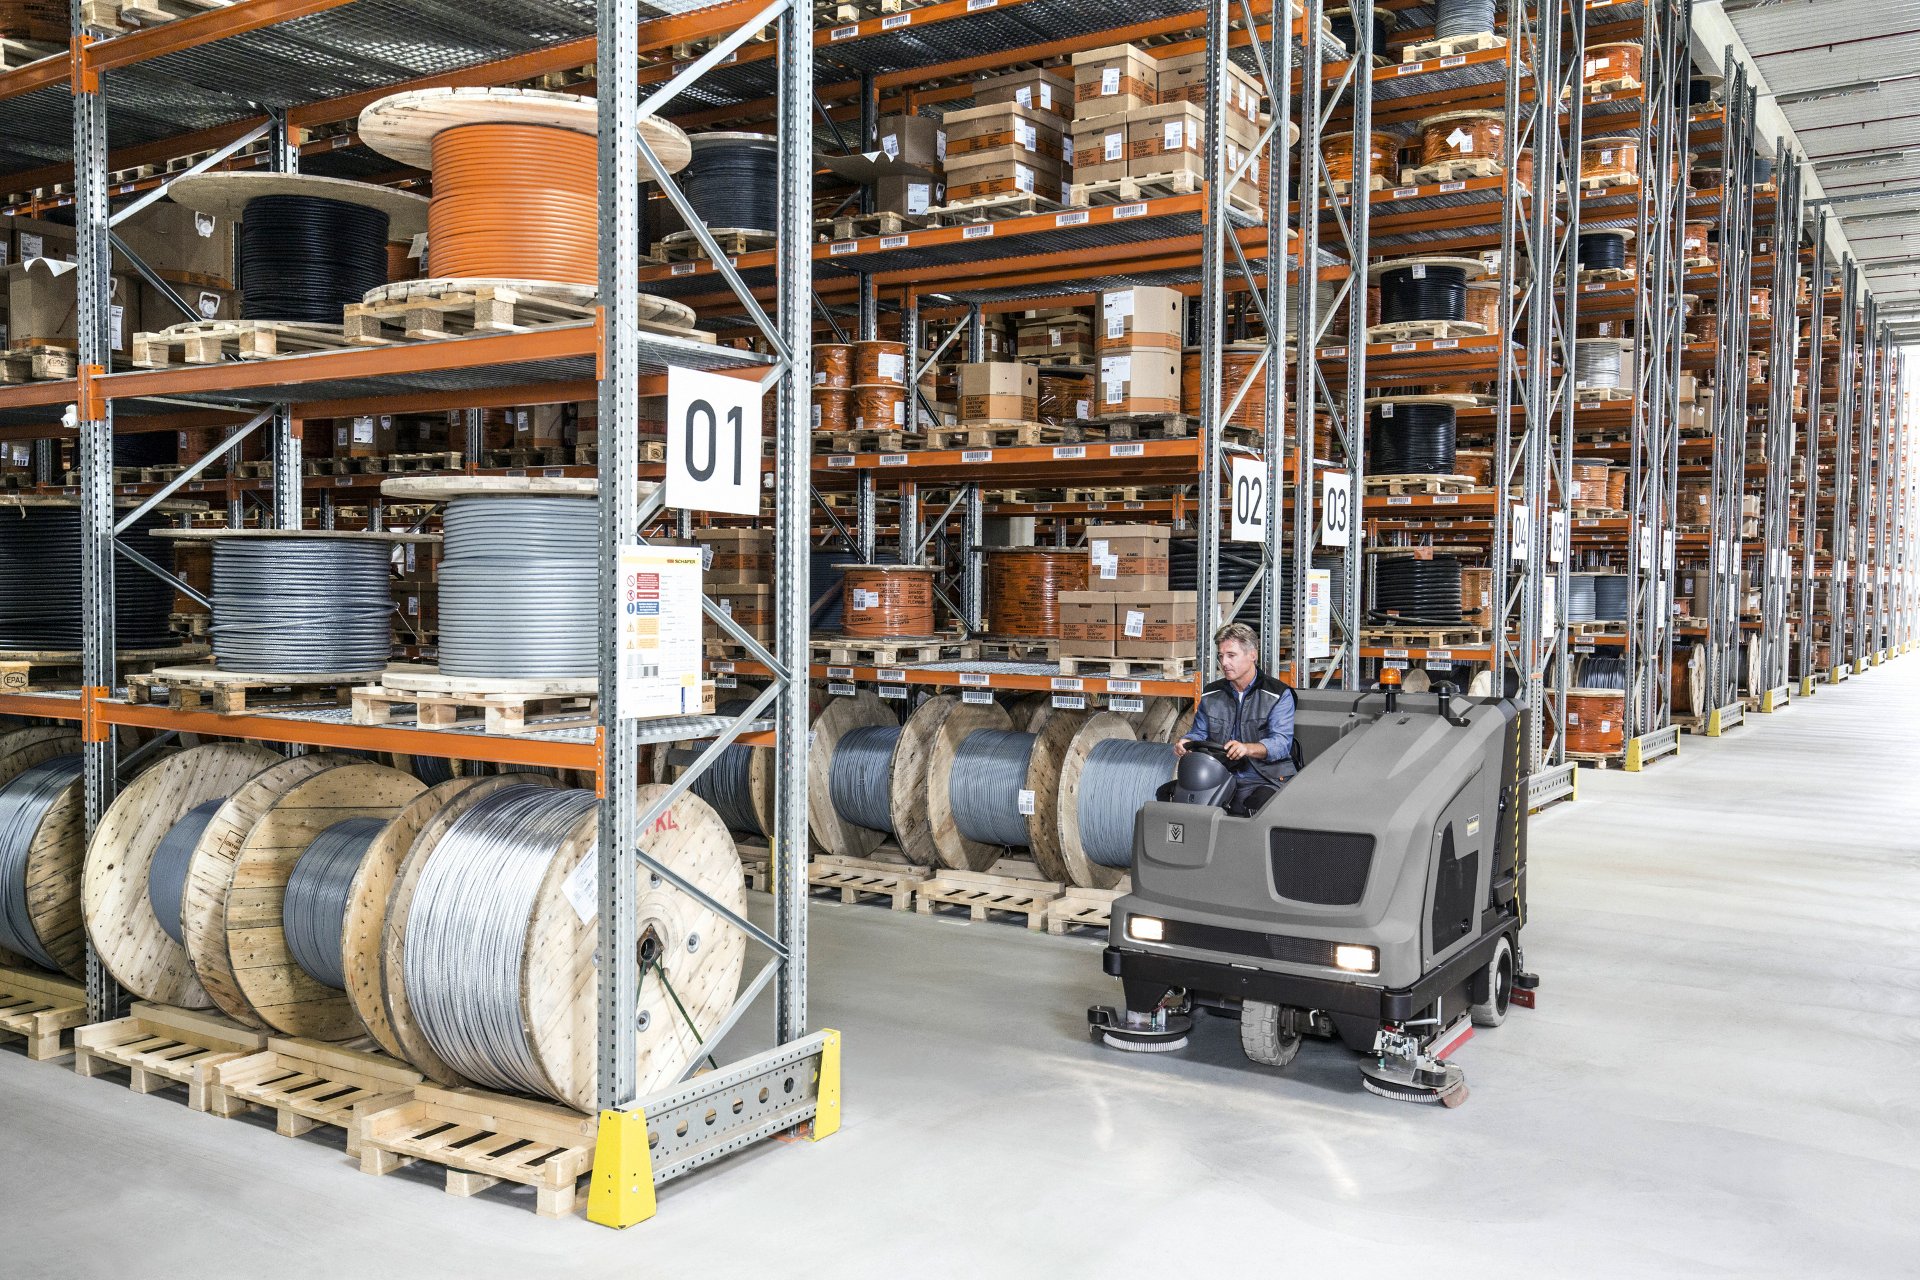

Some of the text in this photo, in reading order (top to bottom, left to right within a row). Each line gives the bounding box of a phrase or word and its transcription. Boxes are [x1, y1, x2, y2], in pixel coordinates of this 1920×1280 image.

[685, 398, 744, 486] 01
[1238, 475, 1262, 525] 02
[1328, 487, 1346, 532] 03
[1514, 516, 1526, 549] 04
[1552, 522, 1563, 552] 05
[644, 810, 679, 835] KL
